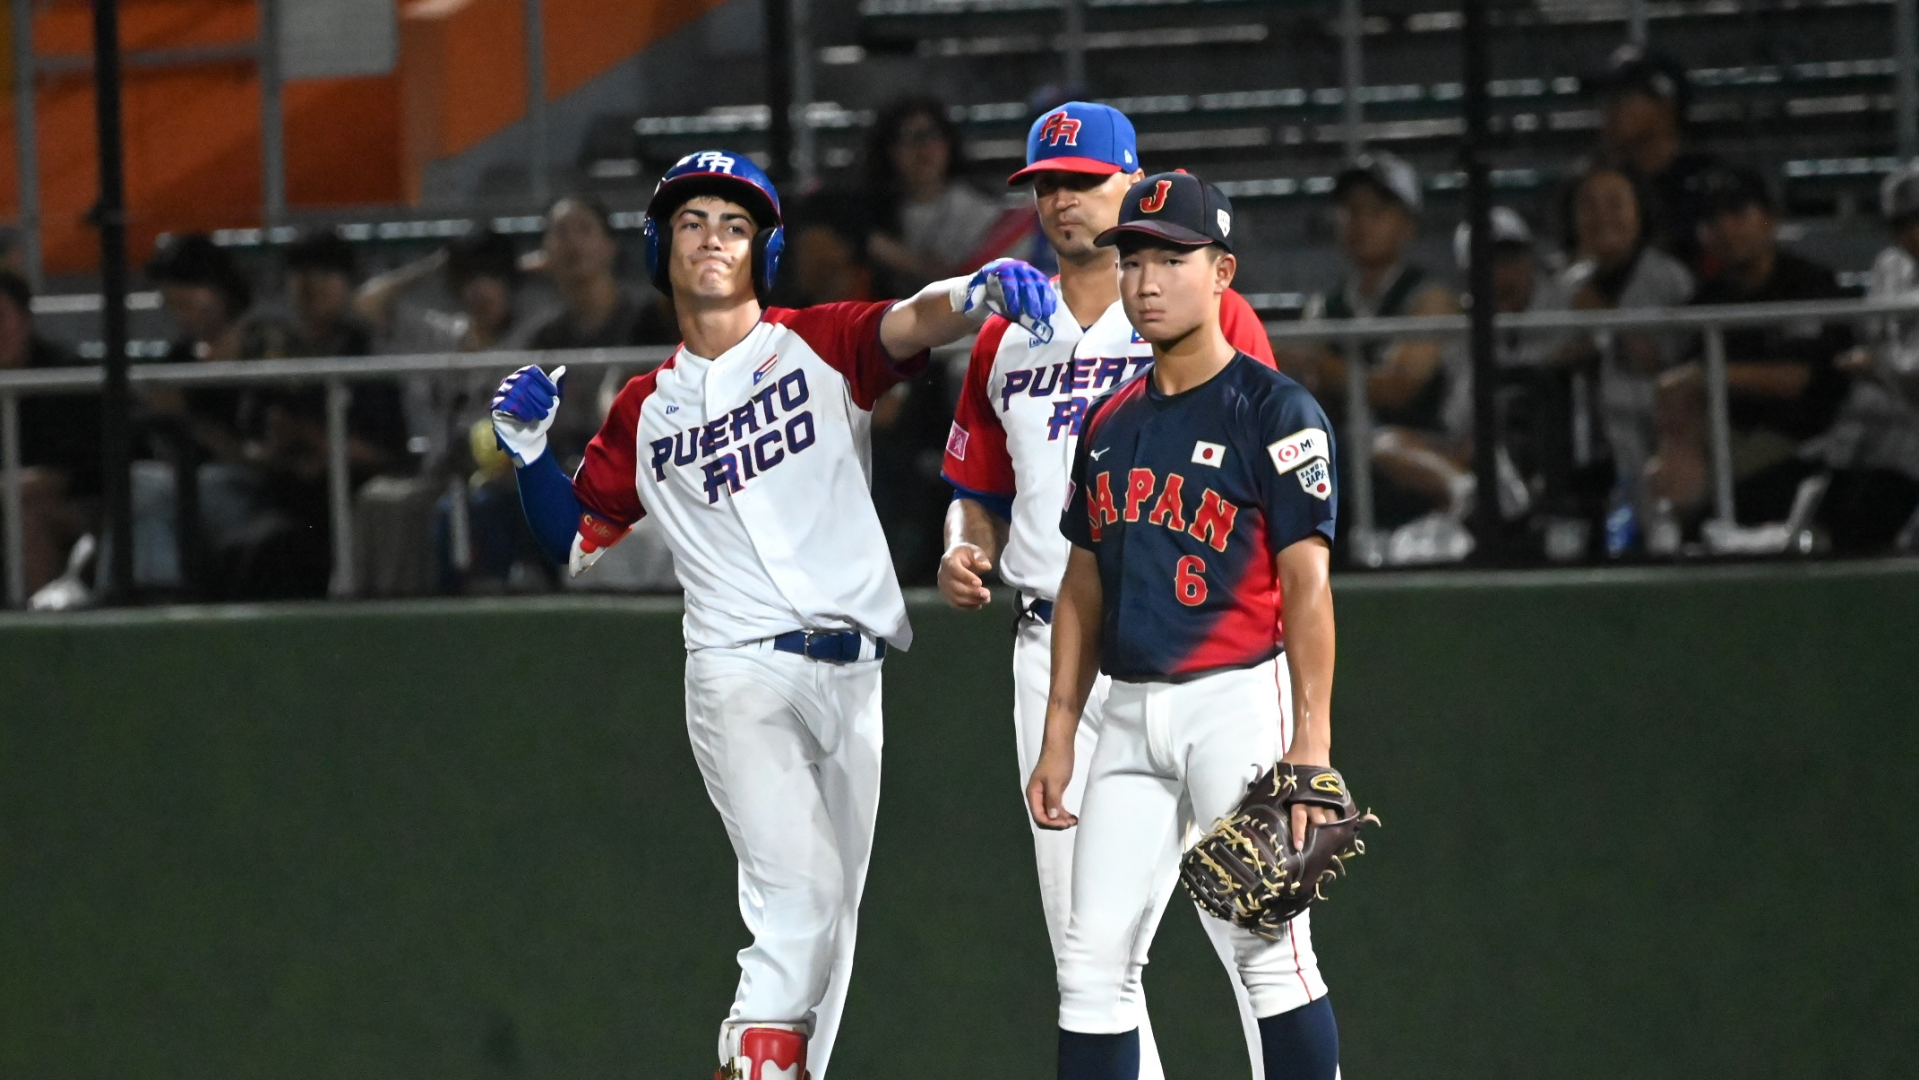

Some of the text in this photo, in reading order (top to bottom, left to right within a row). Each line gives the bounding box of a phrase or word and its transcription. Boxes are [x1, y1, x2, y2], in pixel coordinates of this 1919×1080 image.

[1140, 180, 1173, 214] J
[1001, 355, 1155, 413] PUERT
[649, 367, 810, 483] PUERTO
[699, 410, 816, 506] RICO
[1174, 554, 1209, 607] 6
